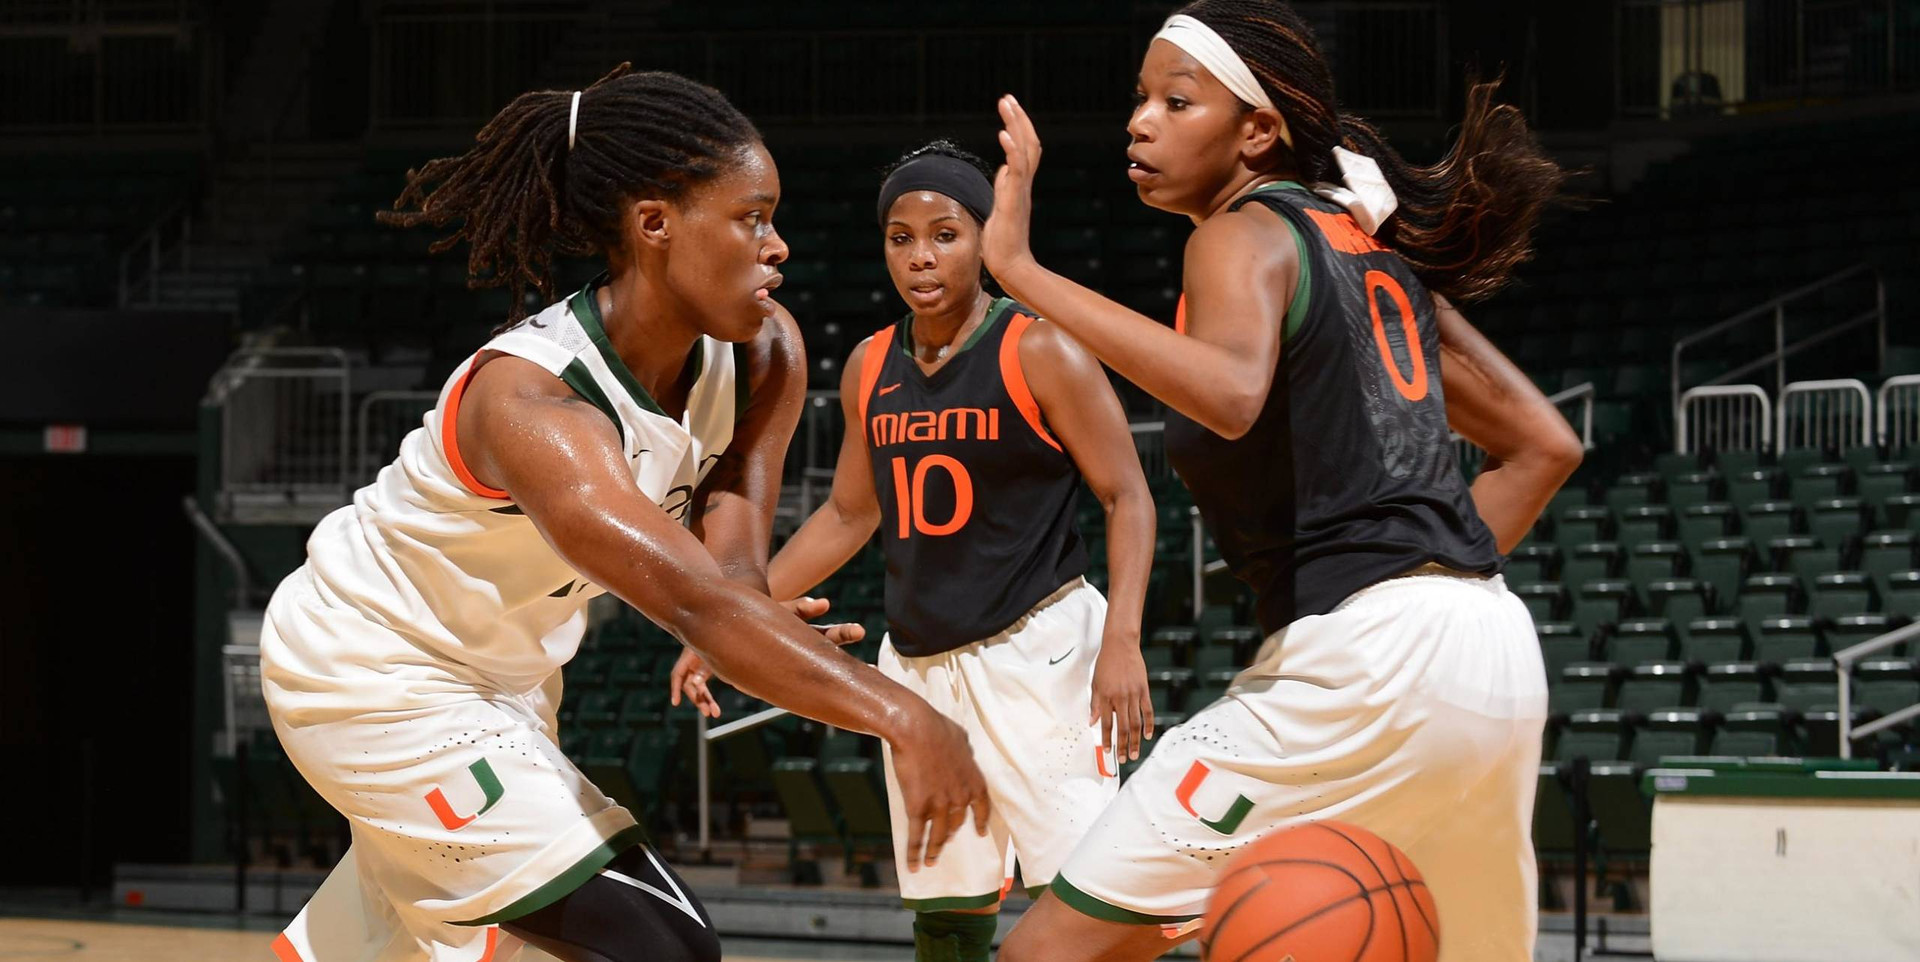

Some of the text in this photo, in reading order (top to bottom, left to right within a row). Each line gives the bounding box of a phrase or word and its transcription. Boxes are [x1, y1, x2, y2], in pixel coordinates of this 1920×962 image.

[1364, 269, 1429, 401] 0
[891, 453, 974, 539] 10
[423, 756, 506, 832] U
[1174, 758, 1256, 836] U
